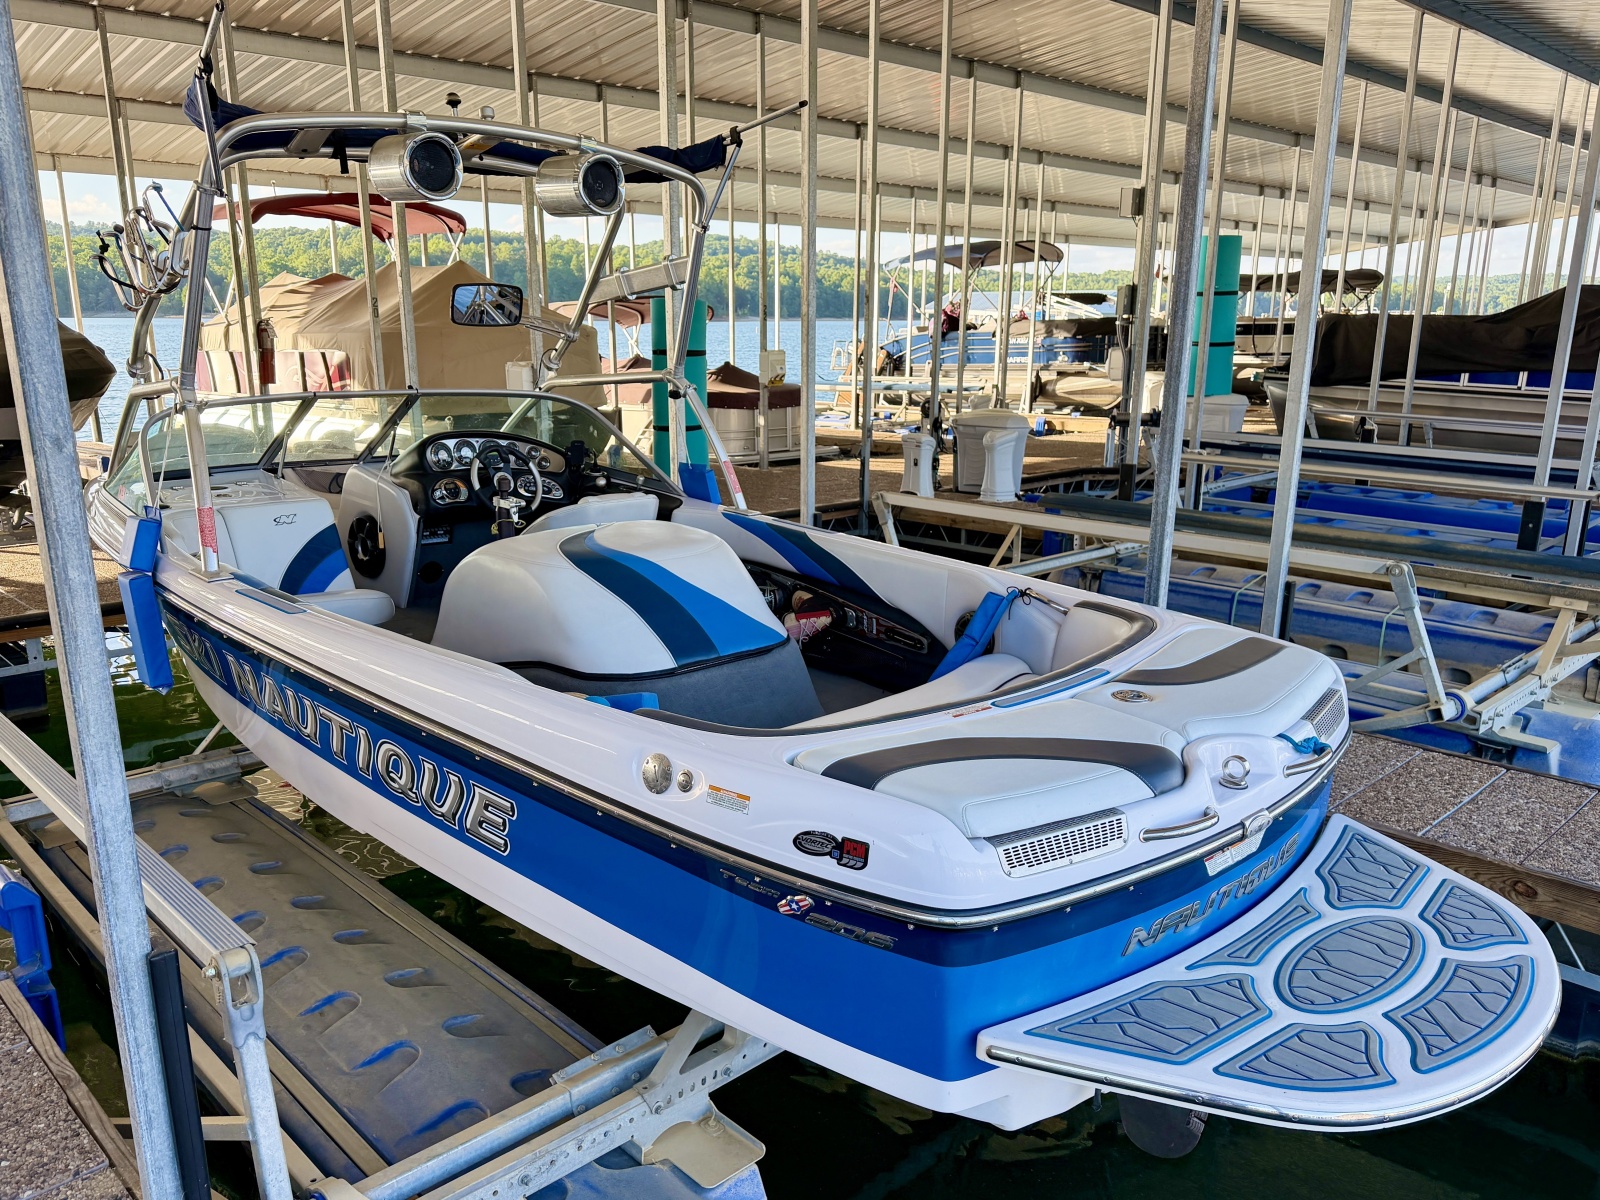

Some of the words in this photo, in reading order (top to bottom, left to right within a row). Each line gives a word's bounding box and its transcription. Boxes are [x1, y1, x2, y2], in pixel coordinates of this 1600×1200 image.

[372, 297, 379, 318] 20
[223, 649, 517, 856] NAUTIQUE
[799, 835, 833, 850] VORTEC
[843, 839, 866, 859] PCM
[1121, 832, 1300, 957] NAUTIQUE
[804, 912, 898, 950] 206
